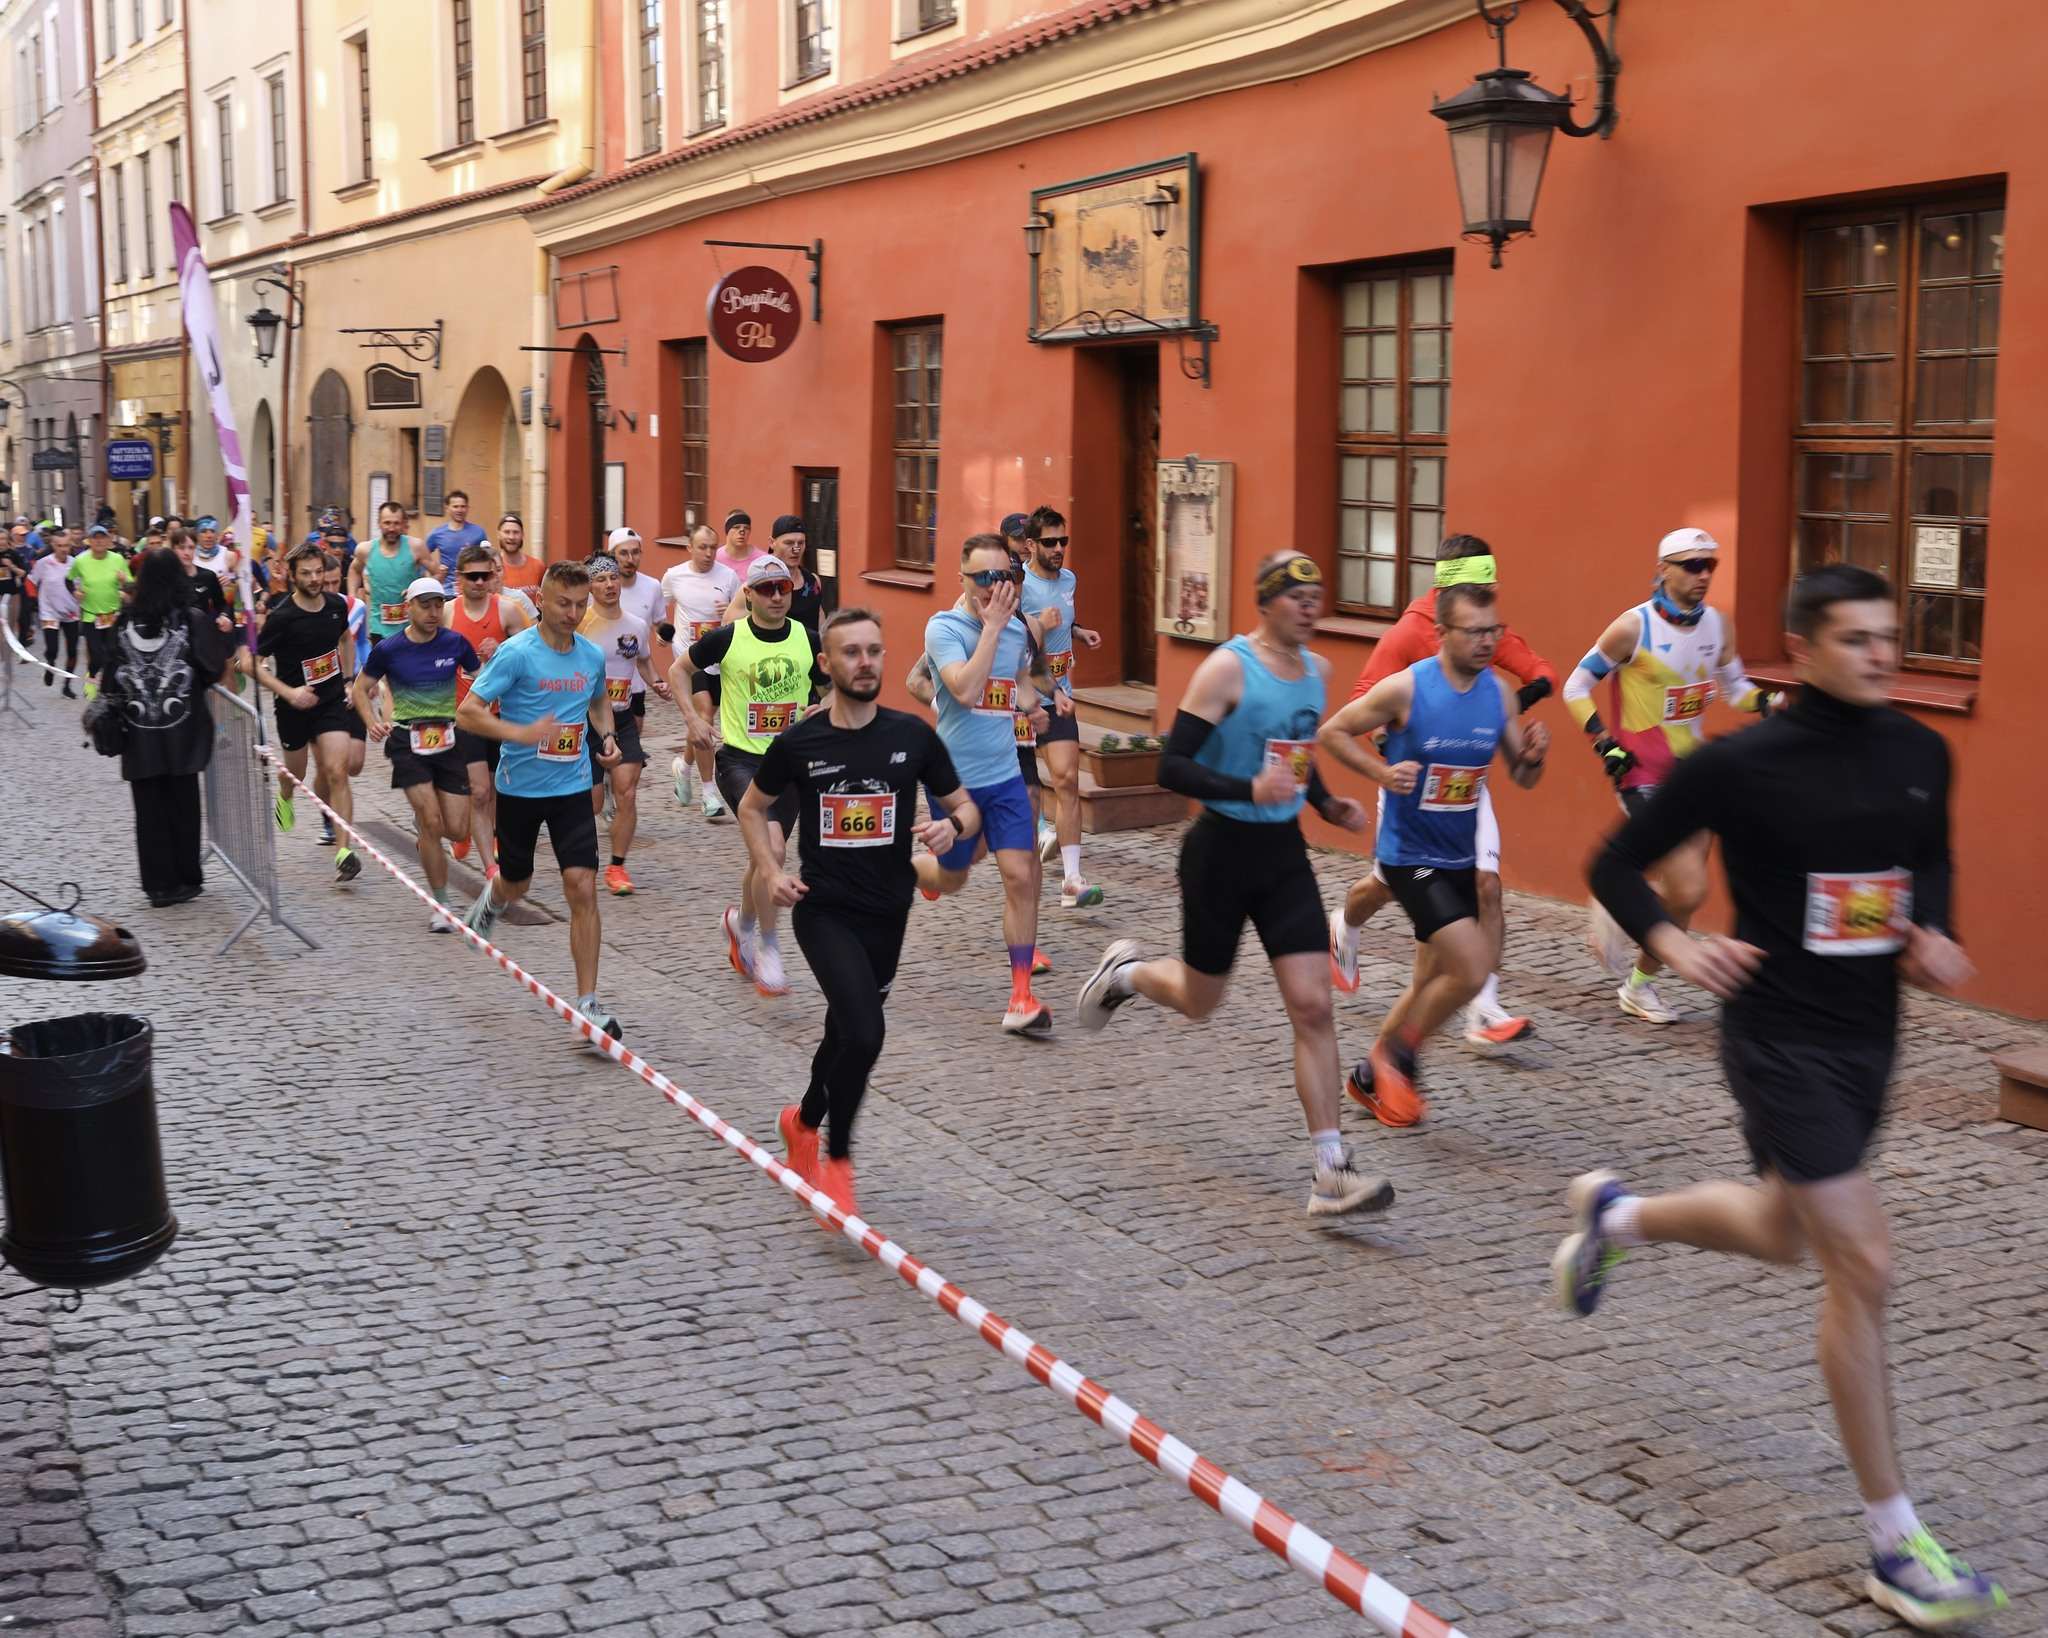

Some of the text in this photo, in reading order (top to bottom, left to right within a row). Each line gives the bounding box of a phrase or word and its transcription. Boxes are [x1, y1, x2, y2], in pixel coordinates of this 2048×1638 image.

[720, 286, 792, 314] Bagatela
[736, 321, 776, 348] Pub
[988, 693, 1007, 705] 113
[761, 716, 786, 728] 367
[557, 738, 573, 750] 84
[840, 816, 876, 832] 666
